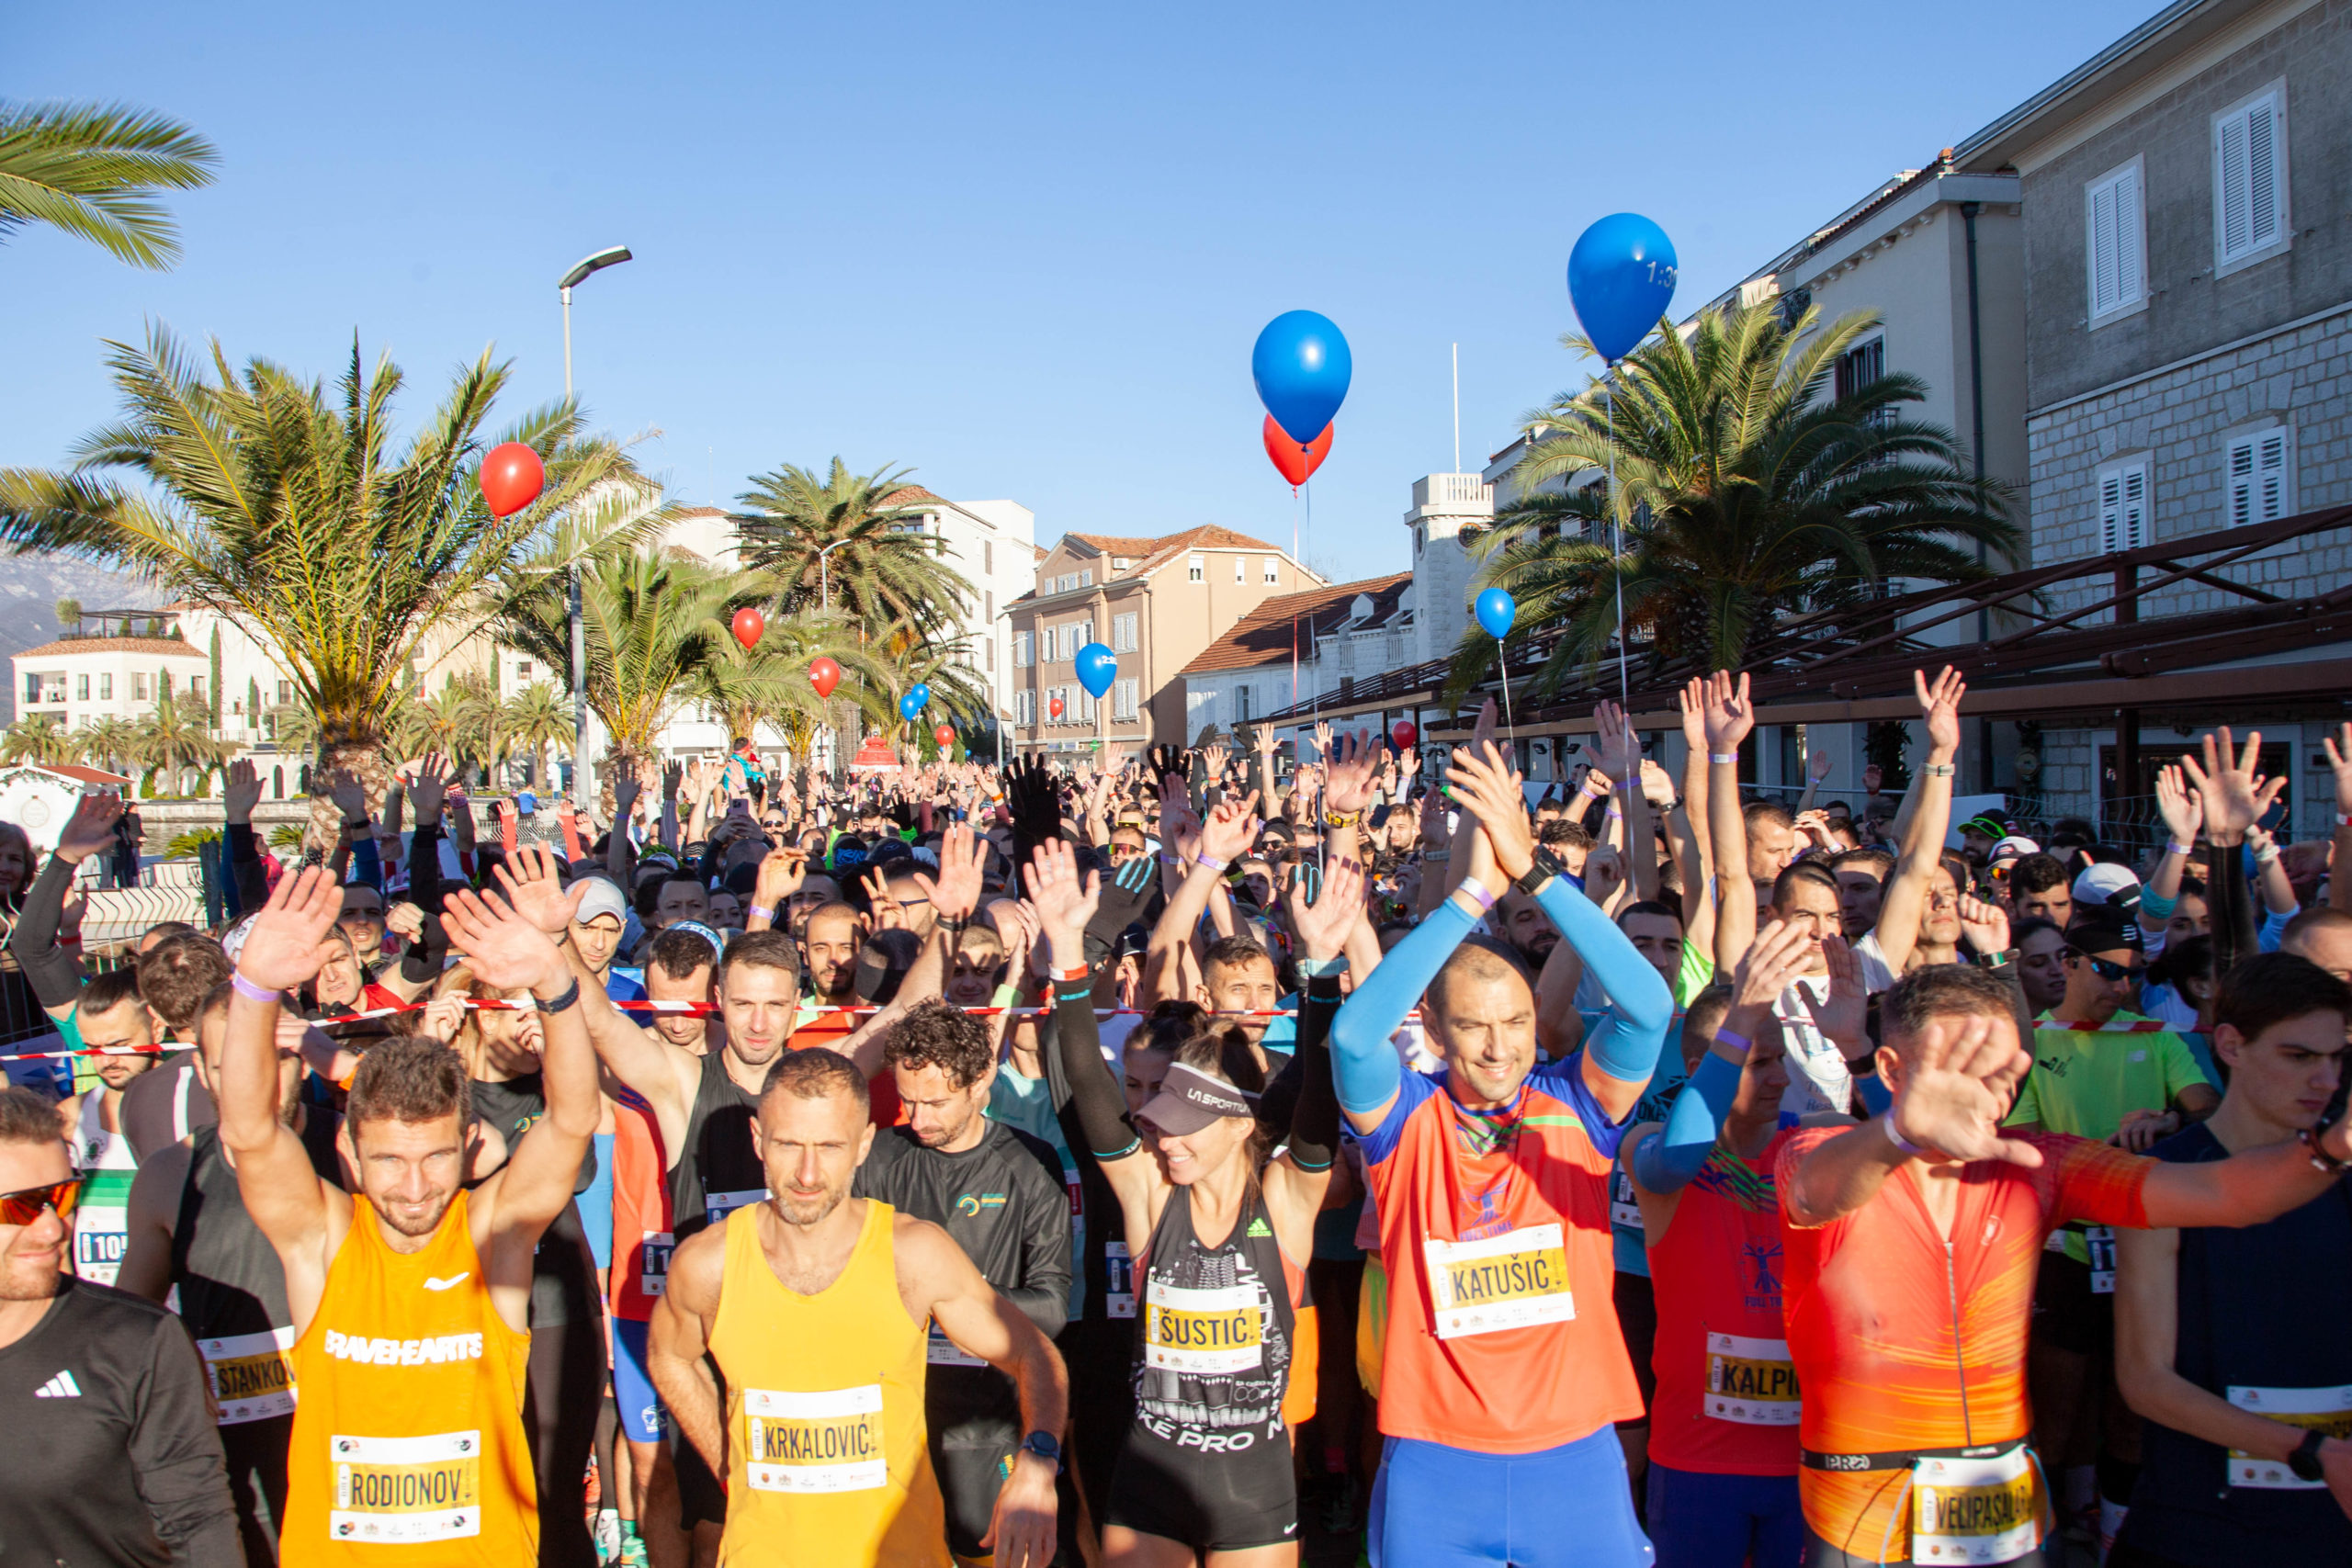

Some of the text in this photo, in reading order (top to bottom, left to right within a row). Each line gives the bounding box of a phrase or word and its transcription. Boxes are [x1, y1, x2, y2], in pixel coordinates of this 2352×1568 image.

[1487, 1220, 1514, 1236] TIME
[1452, 1249, 1550, 1302] KATUŠIĆ
[1160, 1307, 1248, 1346] ŠUSTIĆ
[324, 1328, 483, 1366] BRAVEHEARTS
[765, 1414, 869, 1460] KRKALOVIĆ
[1176, 1429, 1255, 1453] PRO
[352, 1469, 462, 1507] RODIONOV
